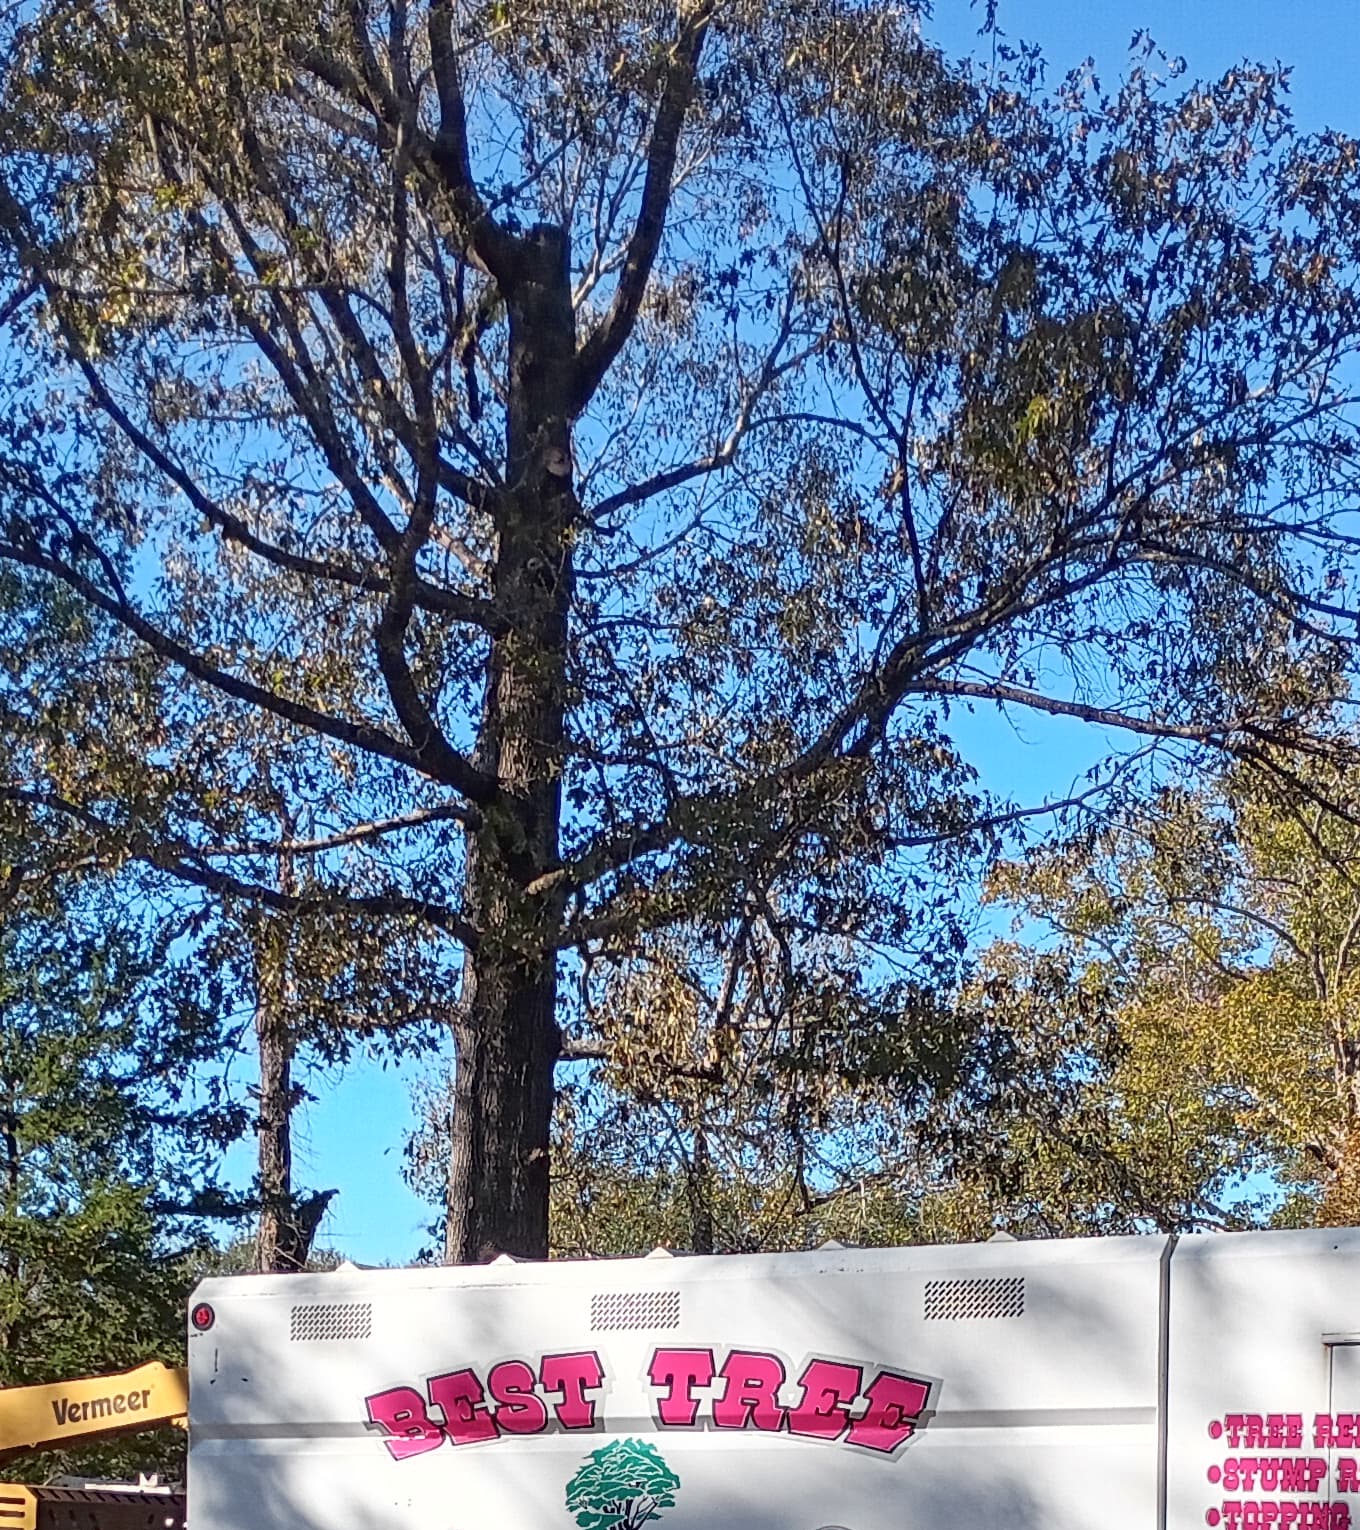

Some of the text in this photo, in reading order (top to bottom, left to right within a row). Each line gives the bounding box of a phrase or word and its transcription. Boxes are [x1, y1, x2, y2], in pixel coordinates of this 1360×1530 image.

[51, 1389, 151, 1426] Vermeer
[366, 1347, 932, 1461] BEST TREE
[1224, 1413, 1304, 1449] TREE
[1222, 1457, 1328, 1492] STUMP
